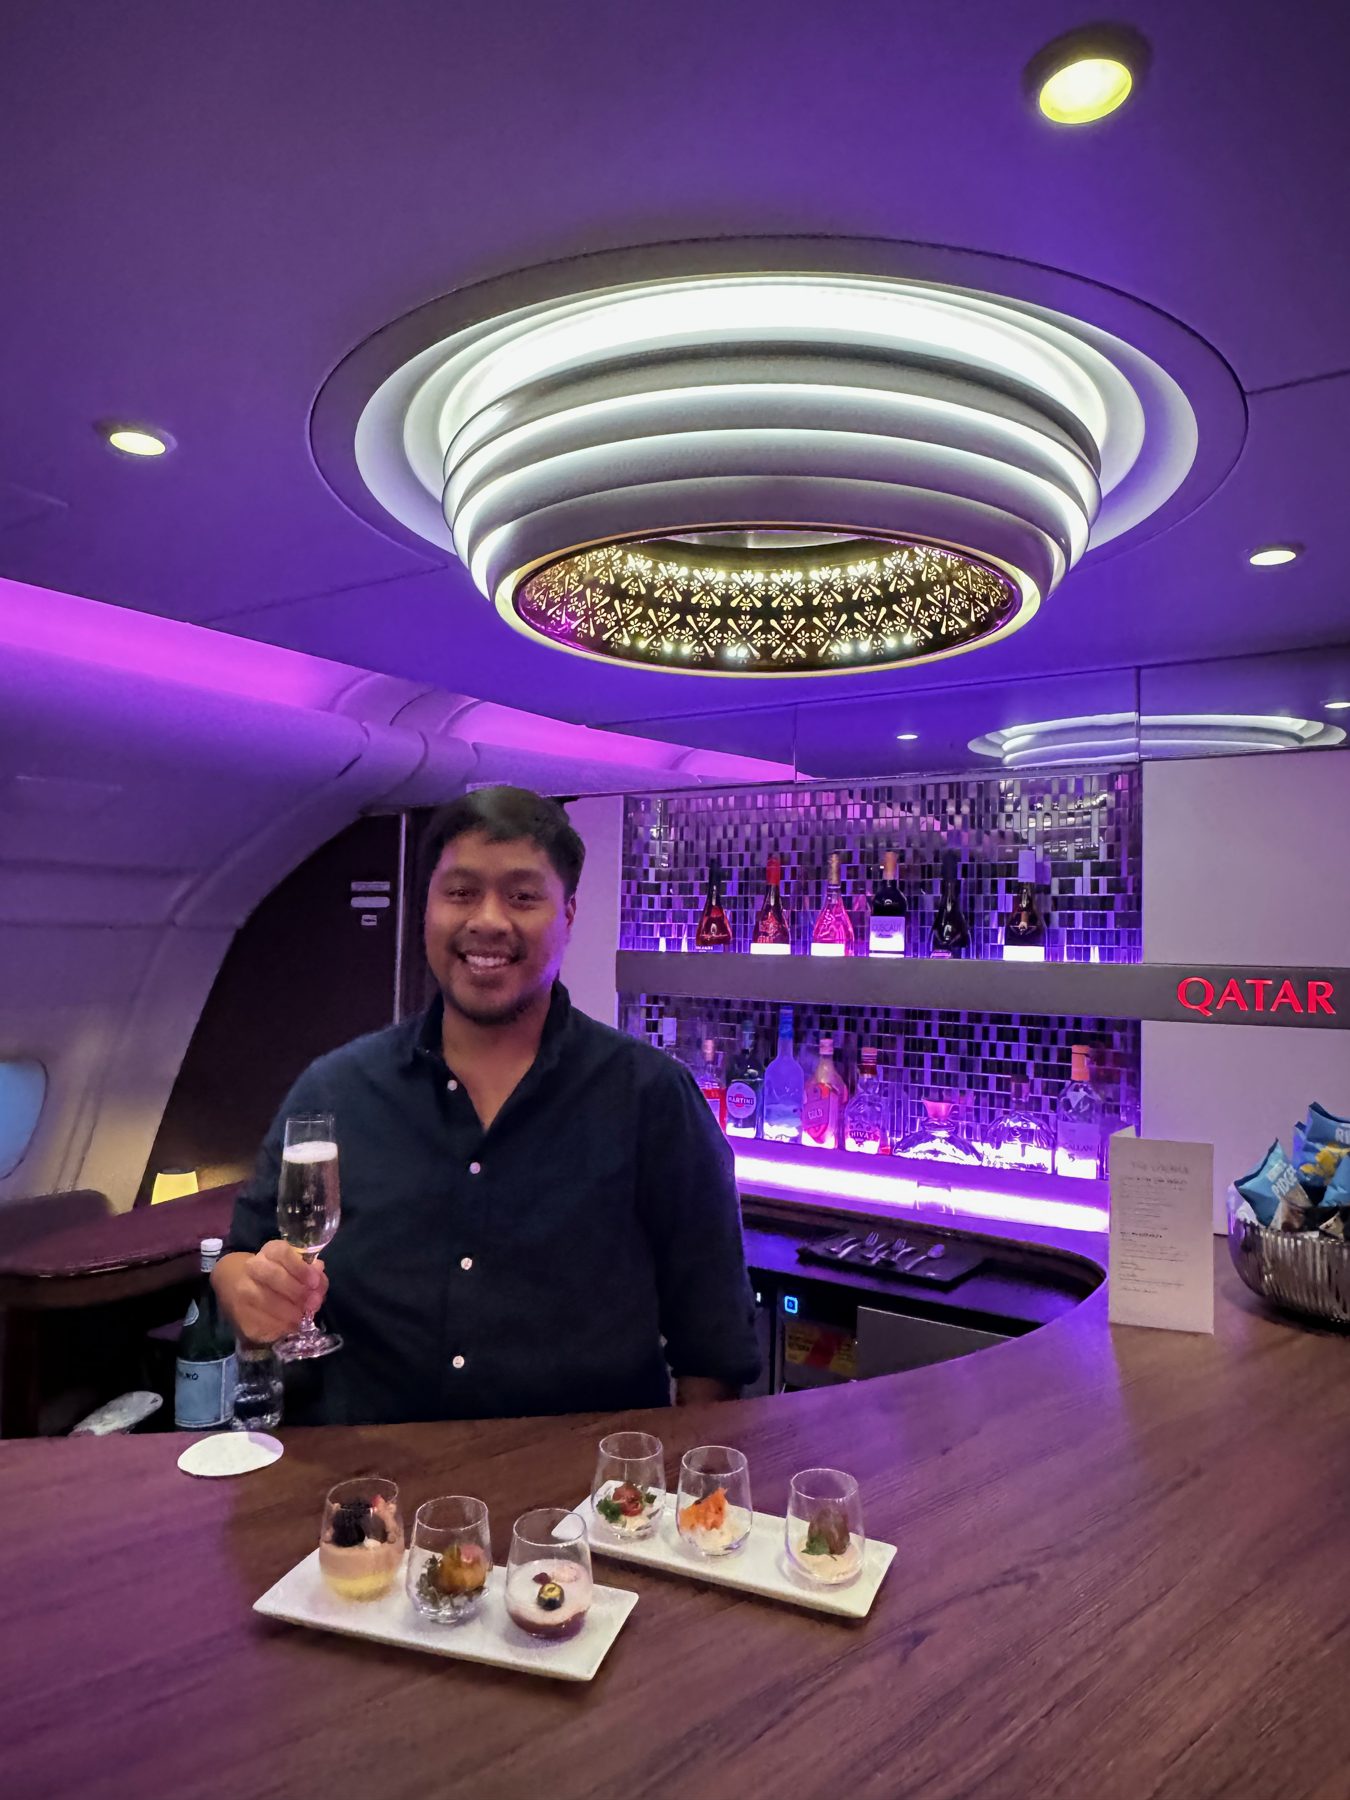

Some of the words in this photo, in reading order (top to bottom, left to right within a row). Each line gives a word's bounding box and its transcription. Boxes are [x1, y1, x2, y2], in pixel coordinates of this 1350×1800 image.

[1177, 976, 1336, 1017] QATAR
[728, 1095, 754, 1105] MARTINI
[849, 1131, 875, 1141] HIVAS
